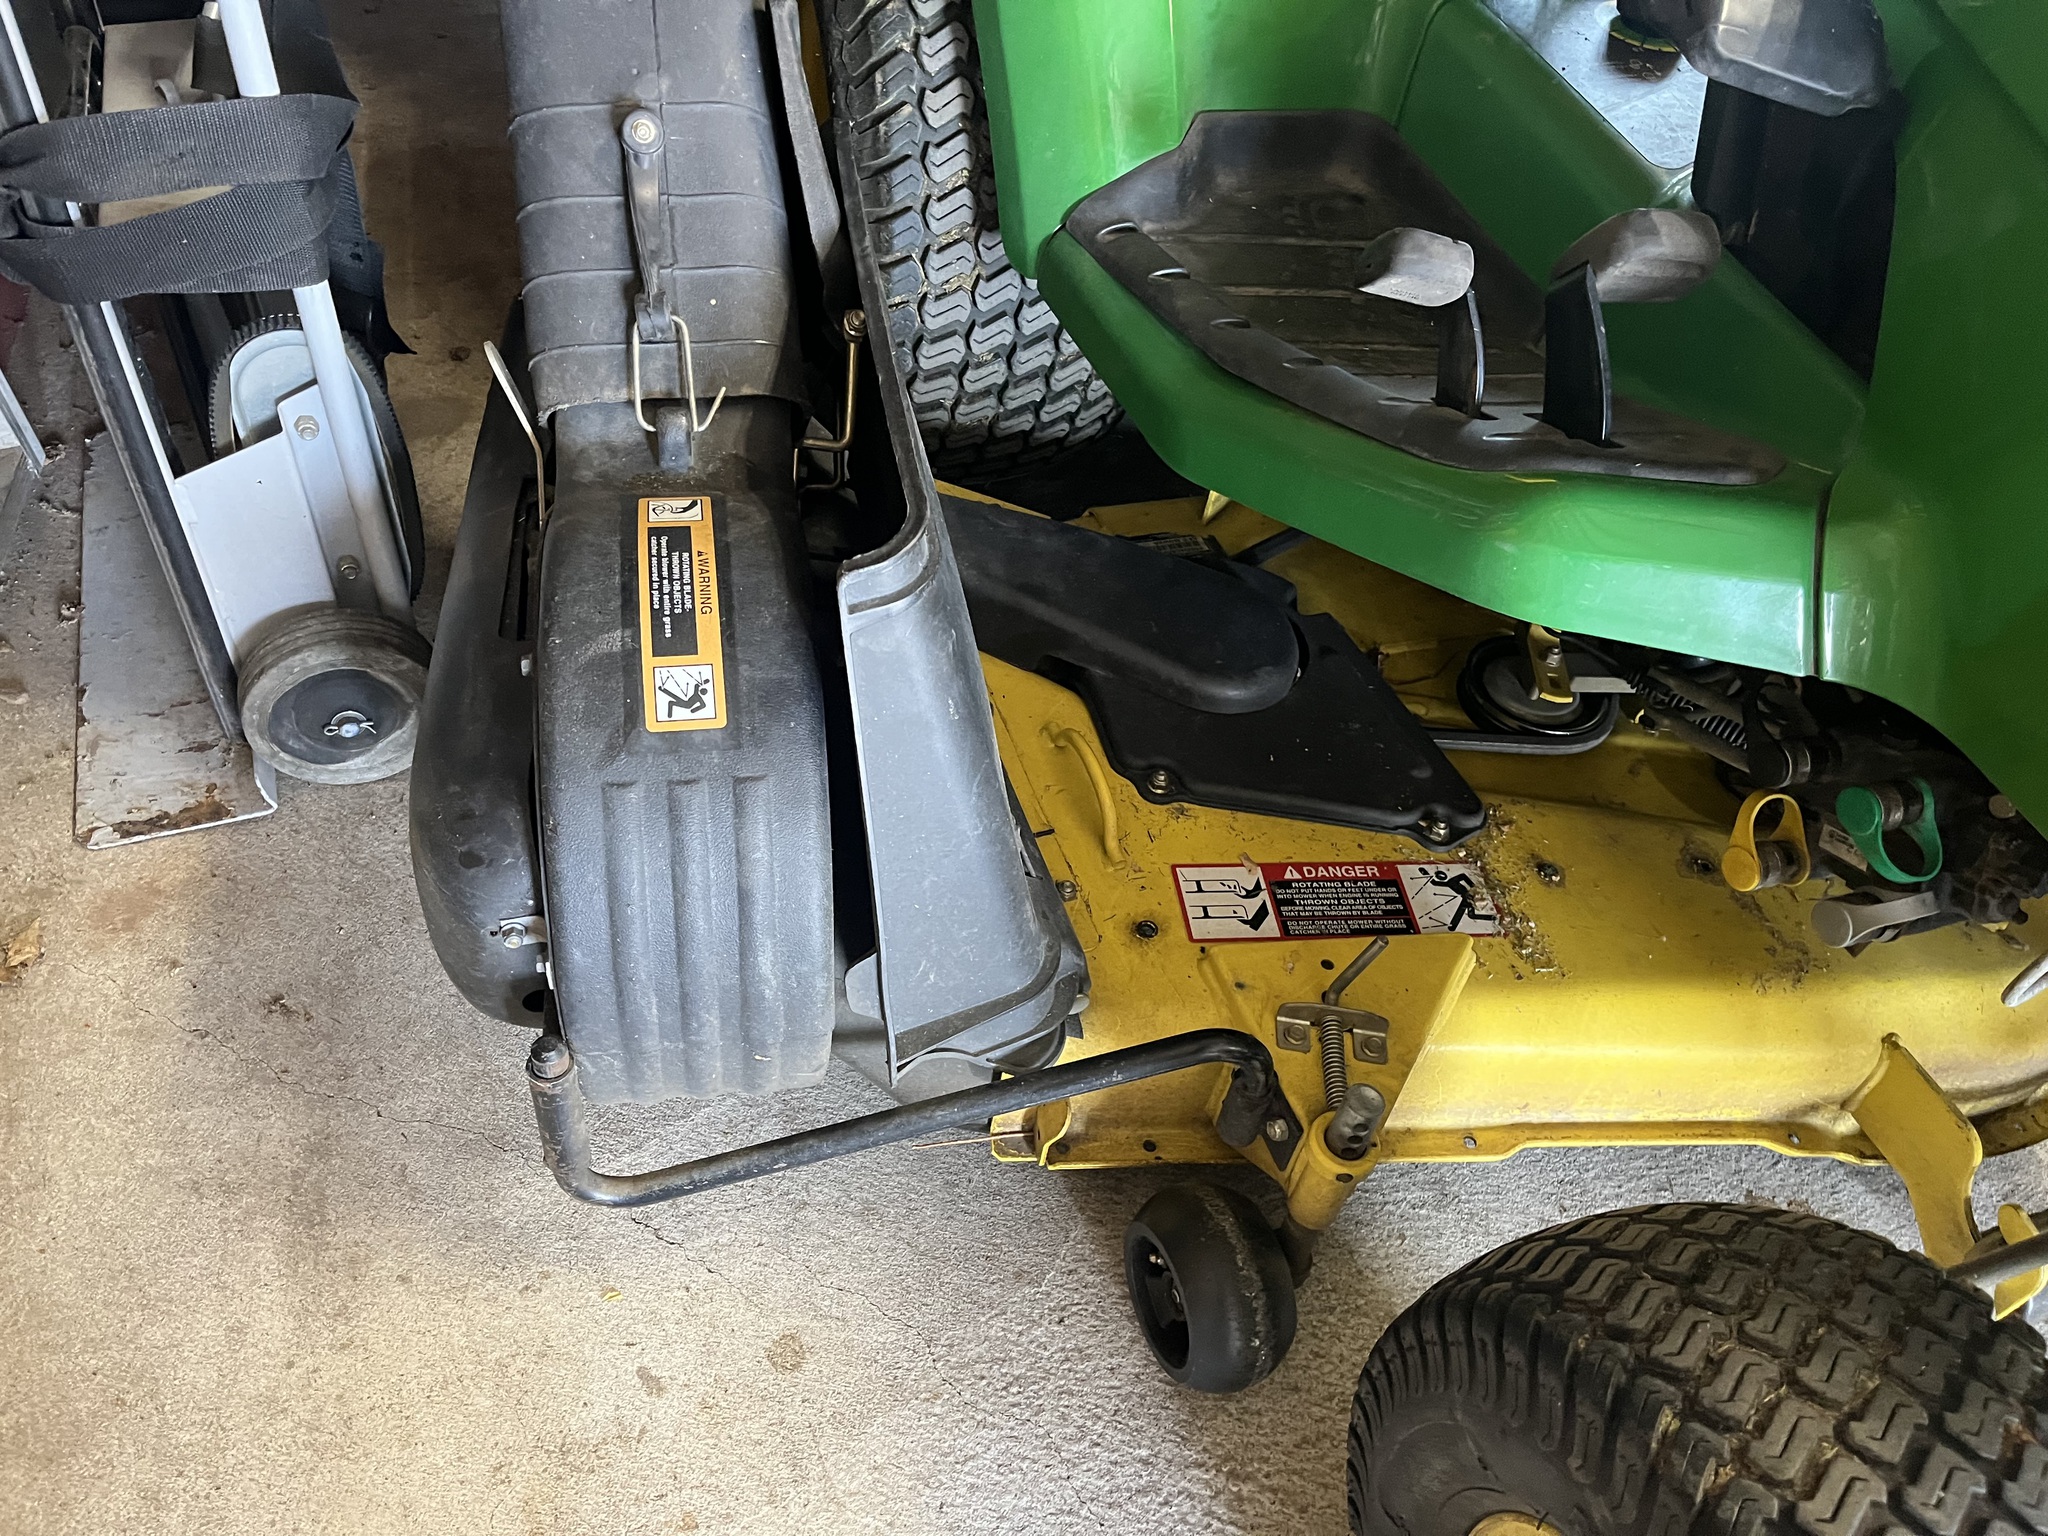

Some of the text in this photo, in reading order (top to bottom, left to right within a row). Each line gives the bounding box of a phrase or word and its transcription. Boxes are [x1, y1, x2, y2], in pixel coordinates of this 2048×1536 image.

[660, 536, 668, 556] Operate
[651, 557, 659, 581] secured
[663, 579, 671, 594] with
[671, 551, 682, 614] THROWN OBJECTS
[682, 552, 692, 612] ROTATING BLADE-
[697, 558, 712, 614] WARNING
[651, 590, 660, 609] place
[663, 594, 671, 615] entire
[662, 616, 672, 638] grass
[1302, 865, 1380, 877] DANGER
